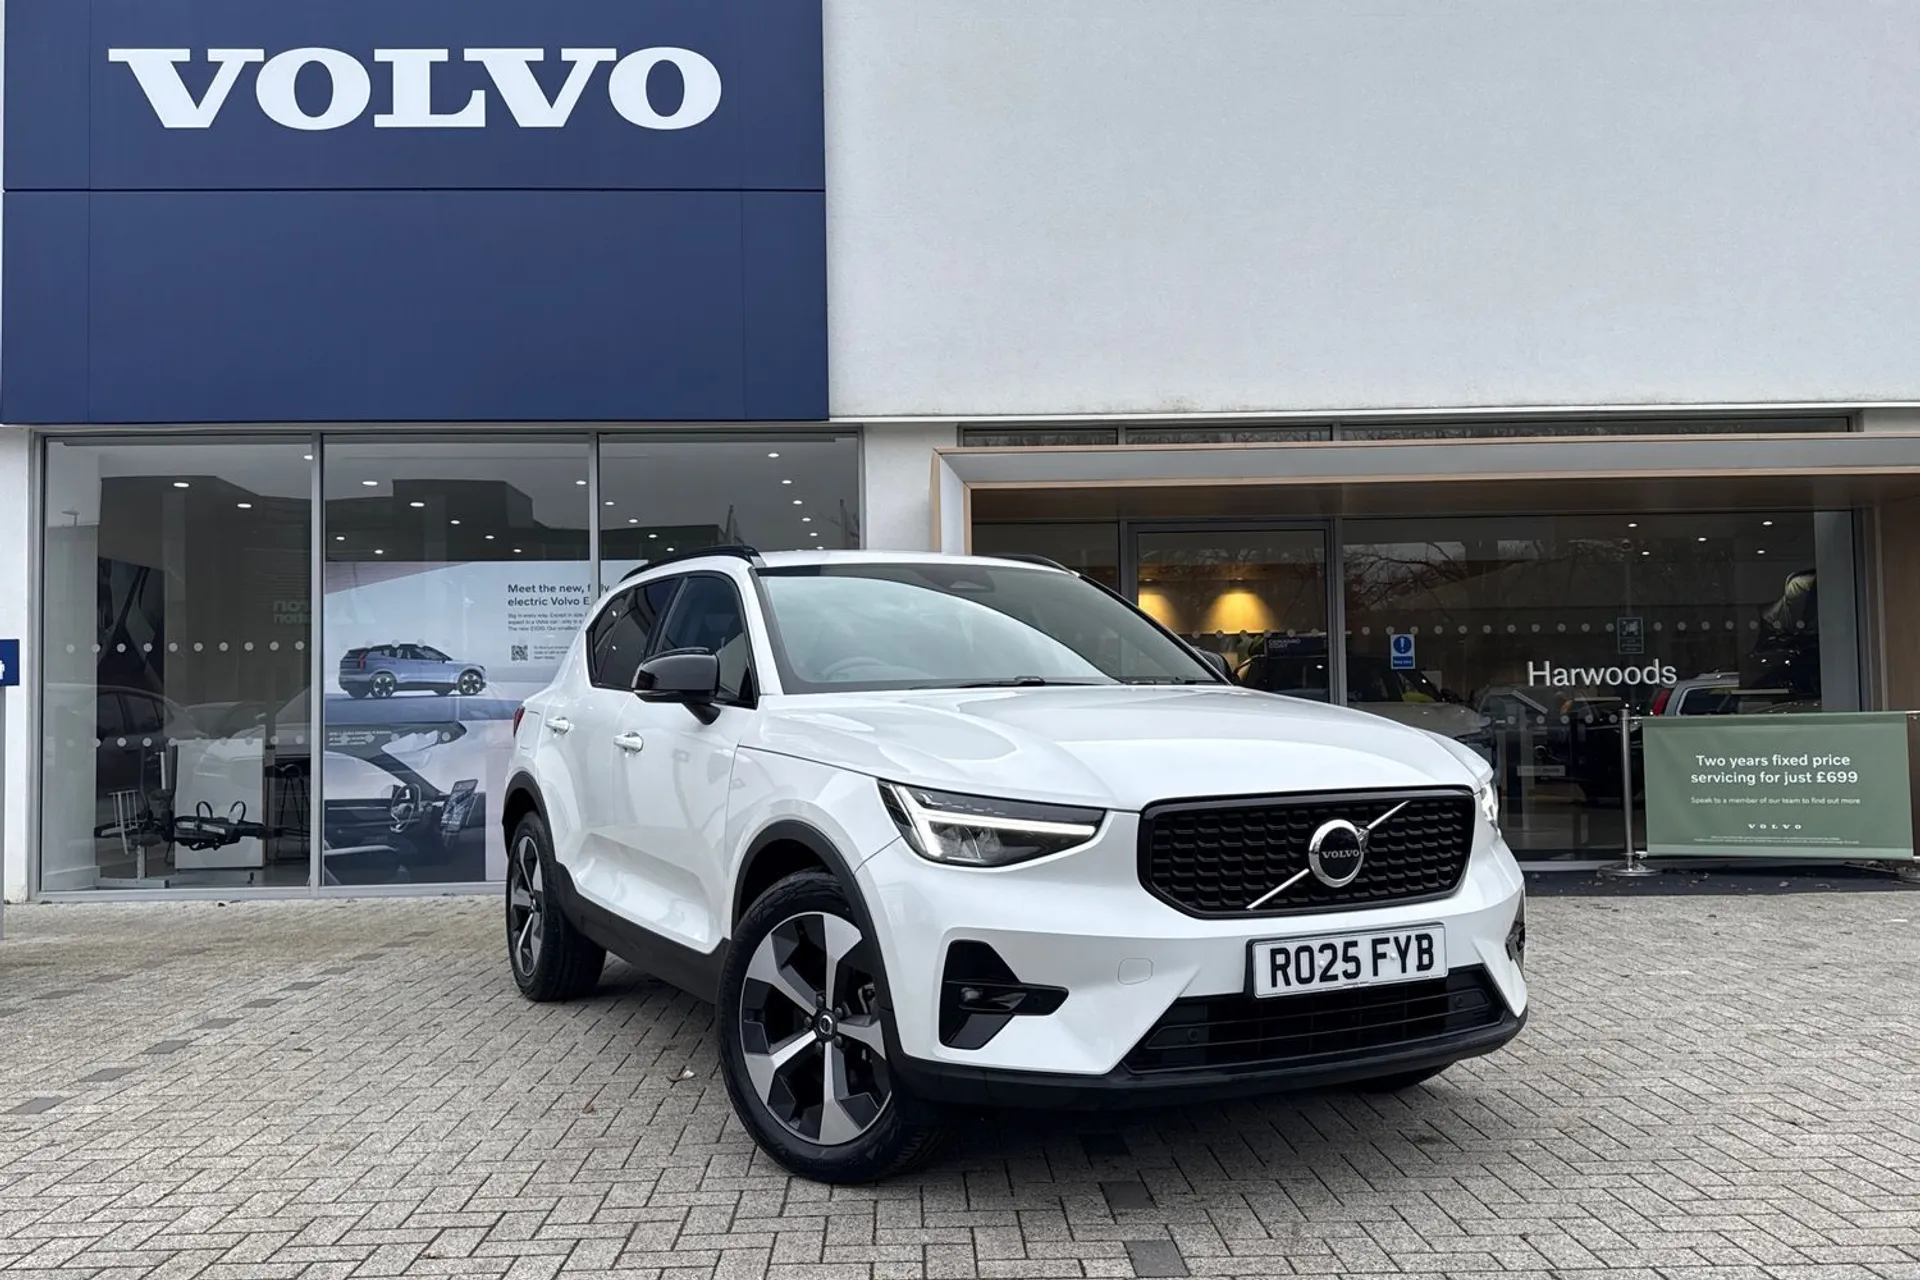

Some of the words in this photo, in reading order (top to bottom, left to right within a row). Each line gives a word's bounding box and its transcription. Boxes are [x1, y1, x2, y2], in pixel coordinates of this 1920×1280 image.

[108, 46, 722, 131] VOLVO
[508, 584, 536, 593] Meet
[539, 584, 557, 593] the
[559, 584, 585, 594] new,
[508, 597, 548, 606] electric
[550, 597, 580, 606] Volvo
[1527, 658, 1677, 687] Harwoods
[1696, 755, 1726, 766] Two
[1729, 756, 1768, 768] years
[1772, 754, 1808, 766] fixed
[1812, 754, 1851, 768] price
[1691, 772, 1756, 785] servicing
[1760, 771, 1780, 783] for
[1783, 772, 1812, 785] just
[1816, 771, 1858, 783] £699
[1690, 796, 1713, 805] Speak
[1322, 849, 1360, 859] VOLVO
[1270, 940, 1361, 988] RO25
[1371, 933, 1434, 977] FYB
